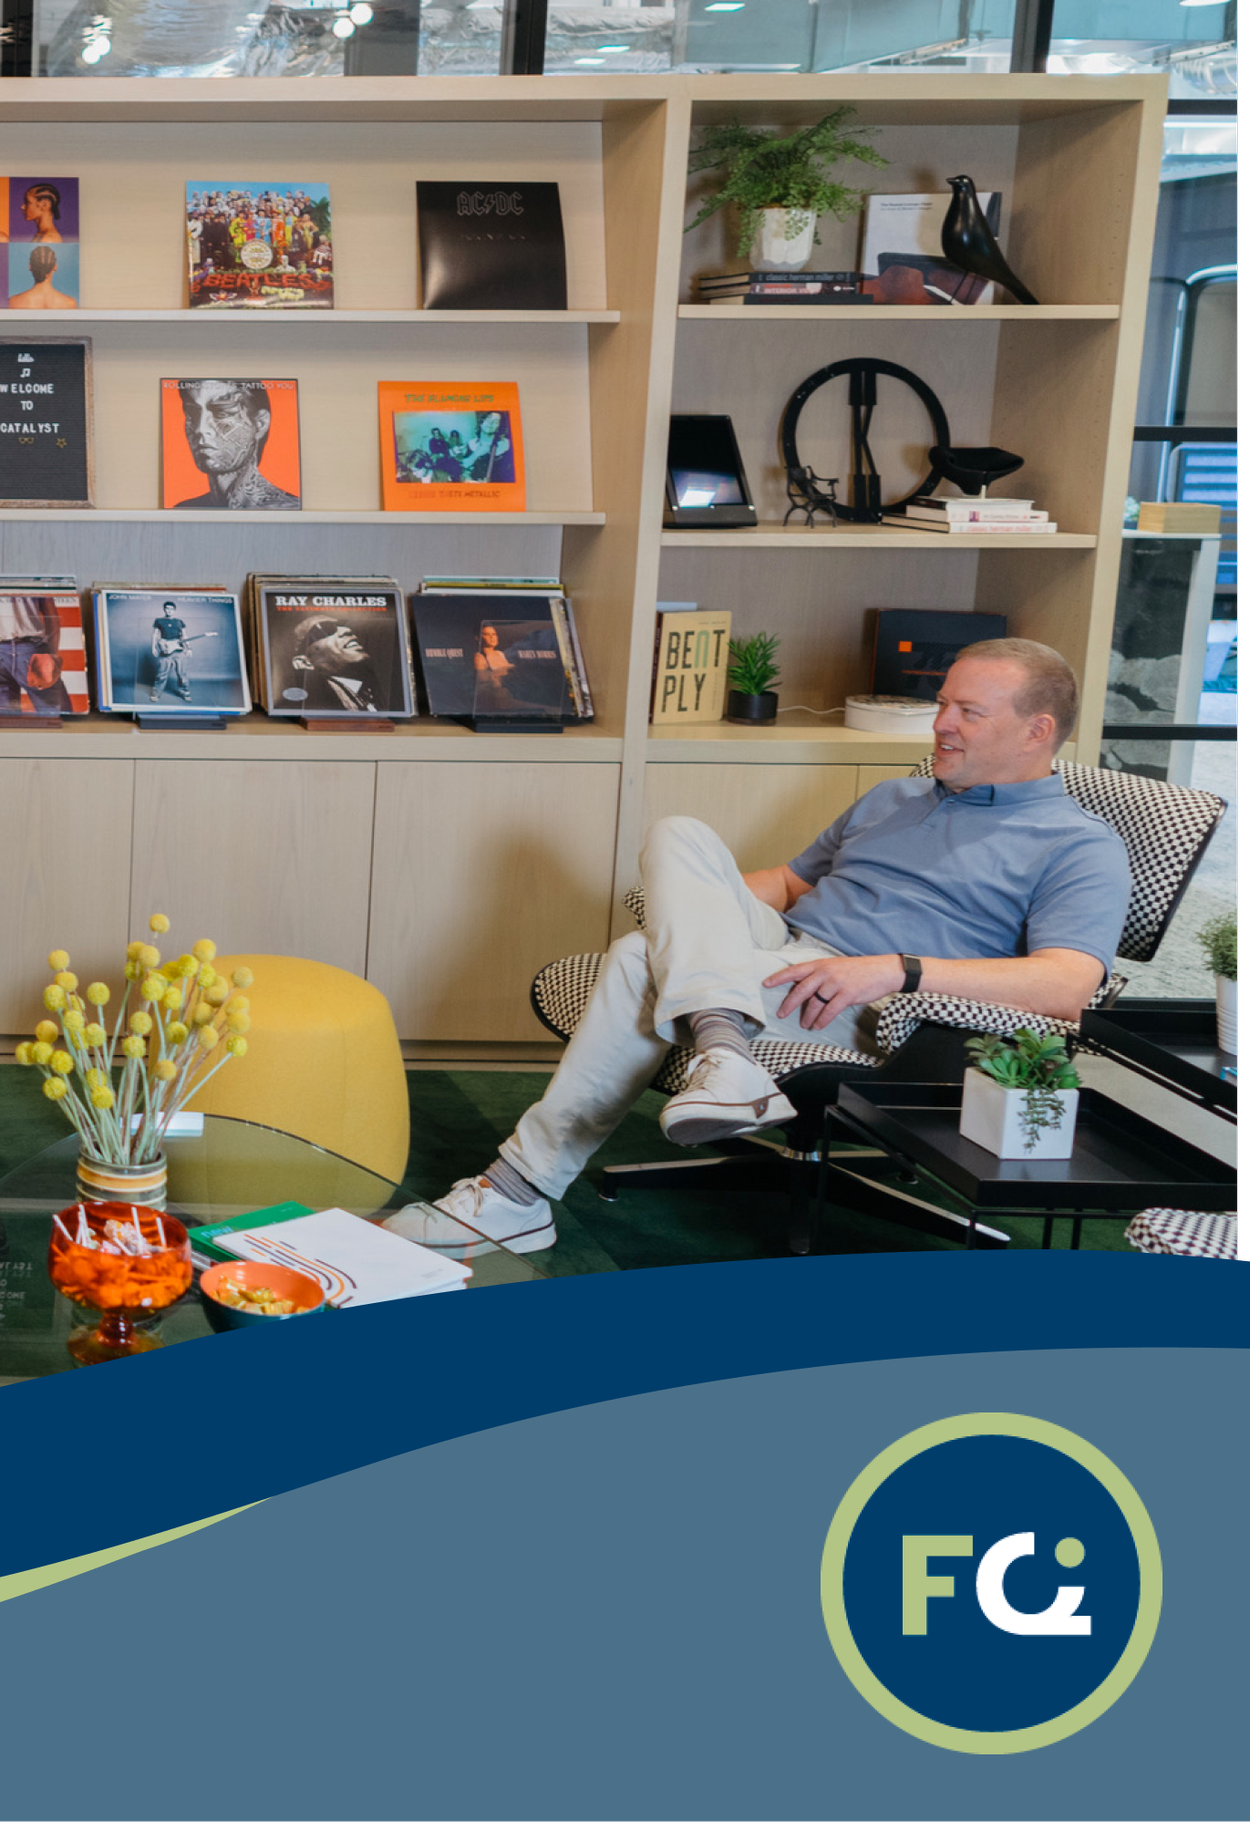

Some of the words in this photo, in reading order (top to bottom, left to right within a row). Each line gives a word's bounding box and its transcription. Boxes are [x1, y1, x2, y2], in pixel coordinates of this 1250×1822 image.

[203, 272, 313, 289] BEATLES
[765, 273, 788, 281] classic
[790, 273, 815, 281] herman
[815, 273, 834, 281] miller
[0, 383, 55, 394] WELCOME
[163, 381, 201, 389] ROLLING
[20, 400, 34, 411] TO
[0, 422, 60, 434] CATALYST
[275, 595, 308, 606] RAY
[311, 595, 387, 607] CHARLES
[447, 648, 464, 659] QUEST
[661, 673, 706, 713] PLY
